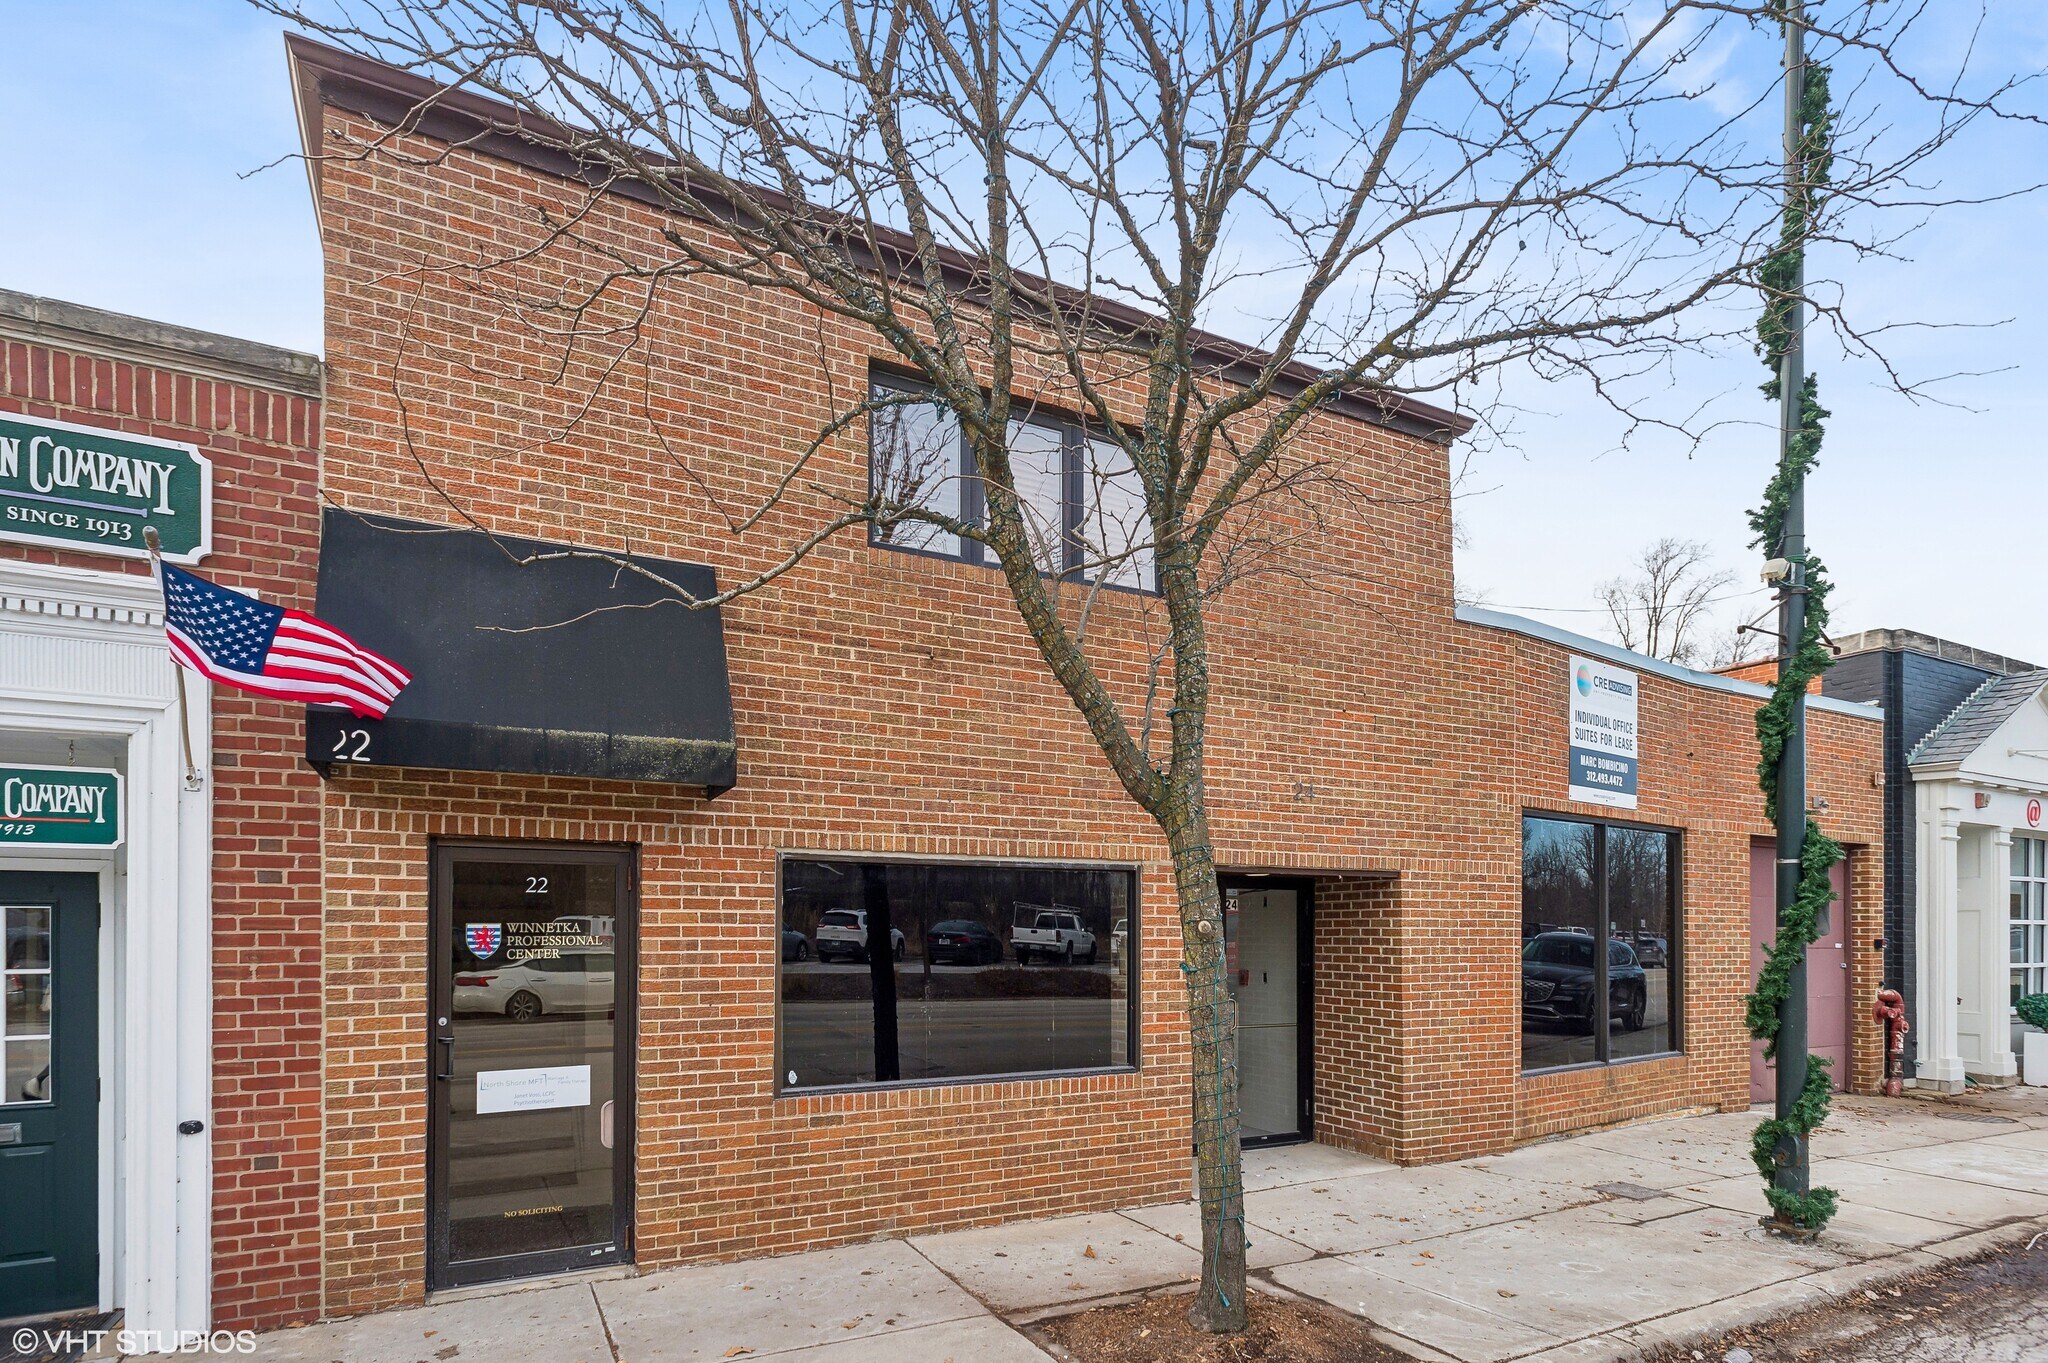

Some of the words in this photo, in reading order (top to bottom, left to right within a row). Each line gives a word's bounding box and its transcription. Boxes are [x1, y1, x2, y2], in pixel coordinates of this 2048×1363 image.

[6, 506, 79, 529] SINCE
[85, 517, 133, 541] 1913
[1593, 675, 1608, 690] CRE
[1609, 680, 1632, 696] ADVISING
[1575, 709, 1612, 730] INDIVIDUAL
[1613, 718, 1633, 735] OFFICE
[332, 729, 371, 762] 22
[1574, 726, 1598, 744] SUITES
[1600, 732, 1613, 747] FOR
[1614, 735, 1633, 751] LEASE
[1580, 754, 1597, 768] MARC
[1586, 770, 1623, 787] 312.493.4472
[525, 876, 549, 894] 22
[1226, 899, 1238, 911] 24
[506, 922, 582, 934] WINNETKA
[506, 935, 603, 947] PROFESSIONAL
[506, 948, 561, 960] CENTER
[483, 1080, 504, 1088] North
[505, 1079, 527, 1087] Shore
[513, 1098, 555, 1106] Psychotherapist
[504, 1210, 517, 1218] NO
[518, 1205, 564, 1217] SOLICITING
